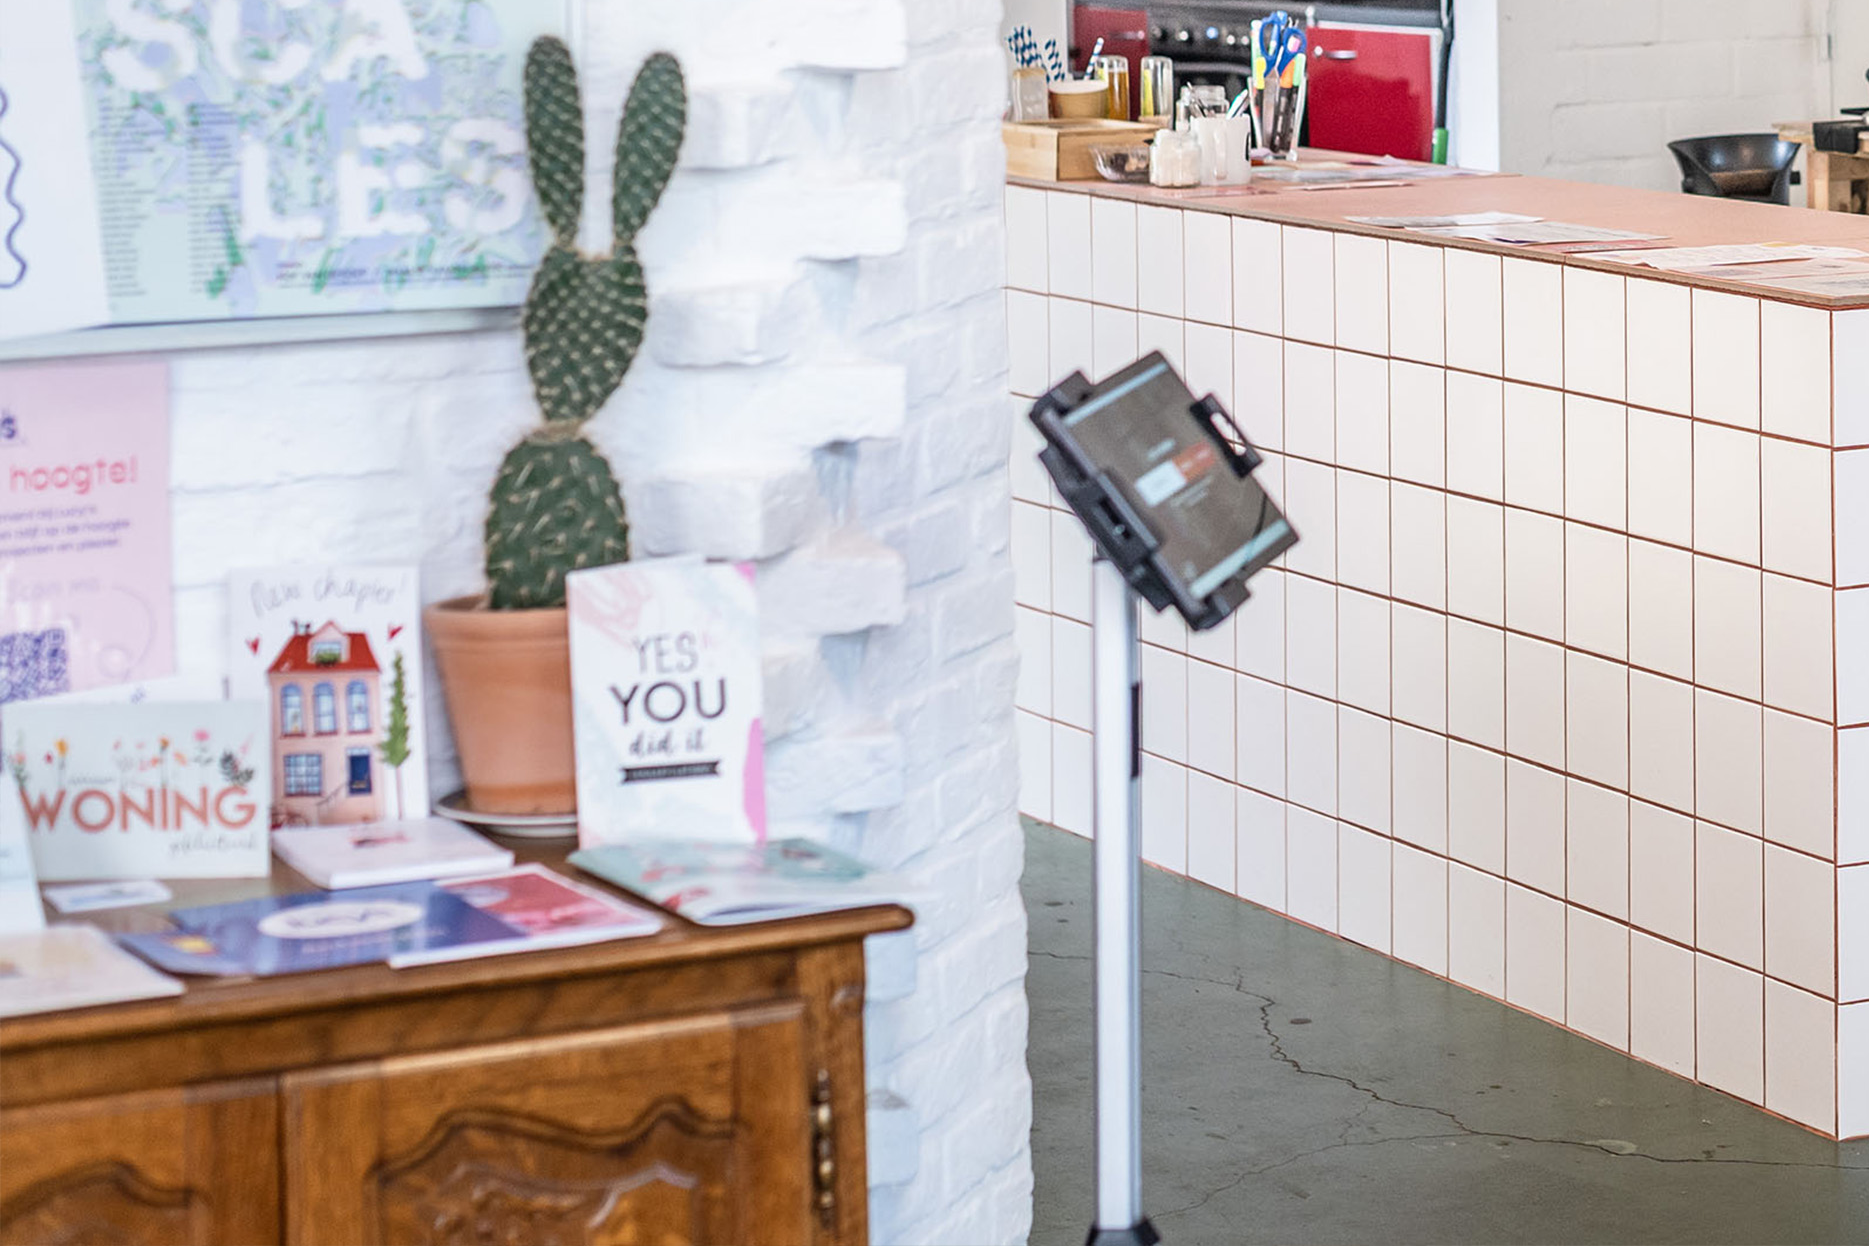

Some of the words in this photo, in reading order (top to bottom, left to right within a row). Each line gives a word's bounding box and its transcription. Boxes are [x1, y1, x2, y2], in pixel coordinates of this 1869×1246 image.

[9, 454, 138, 495] hoogte!
[632, 630, 699, 674] YES
[609, 677, 726, 725] YOU
[629, 730, 674, 758] did
[19, 783, 258, 834] WONING
